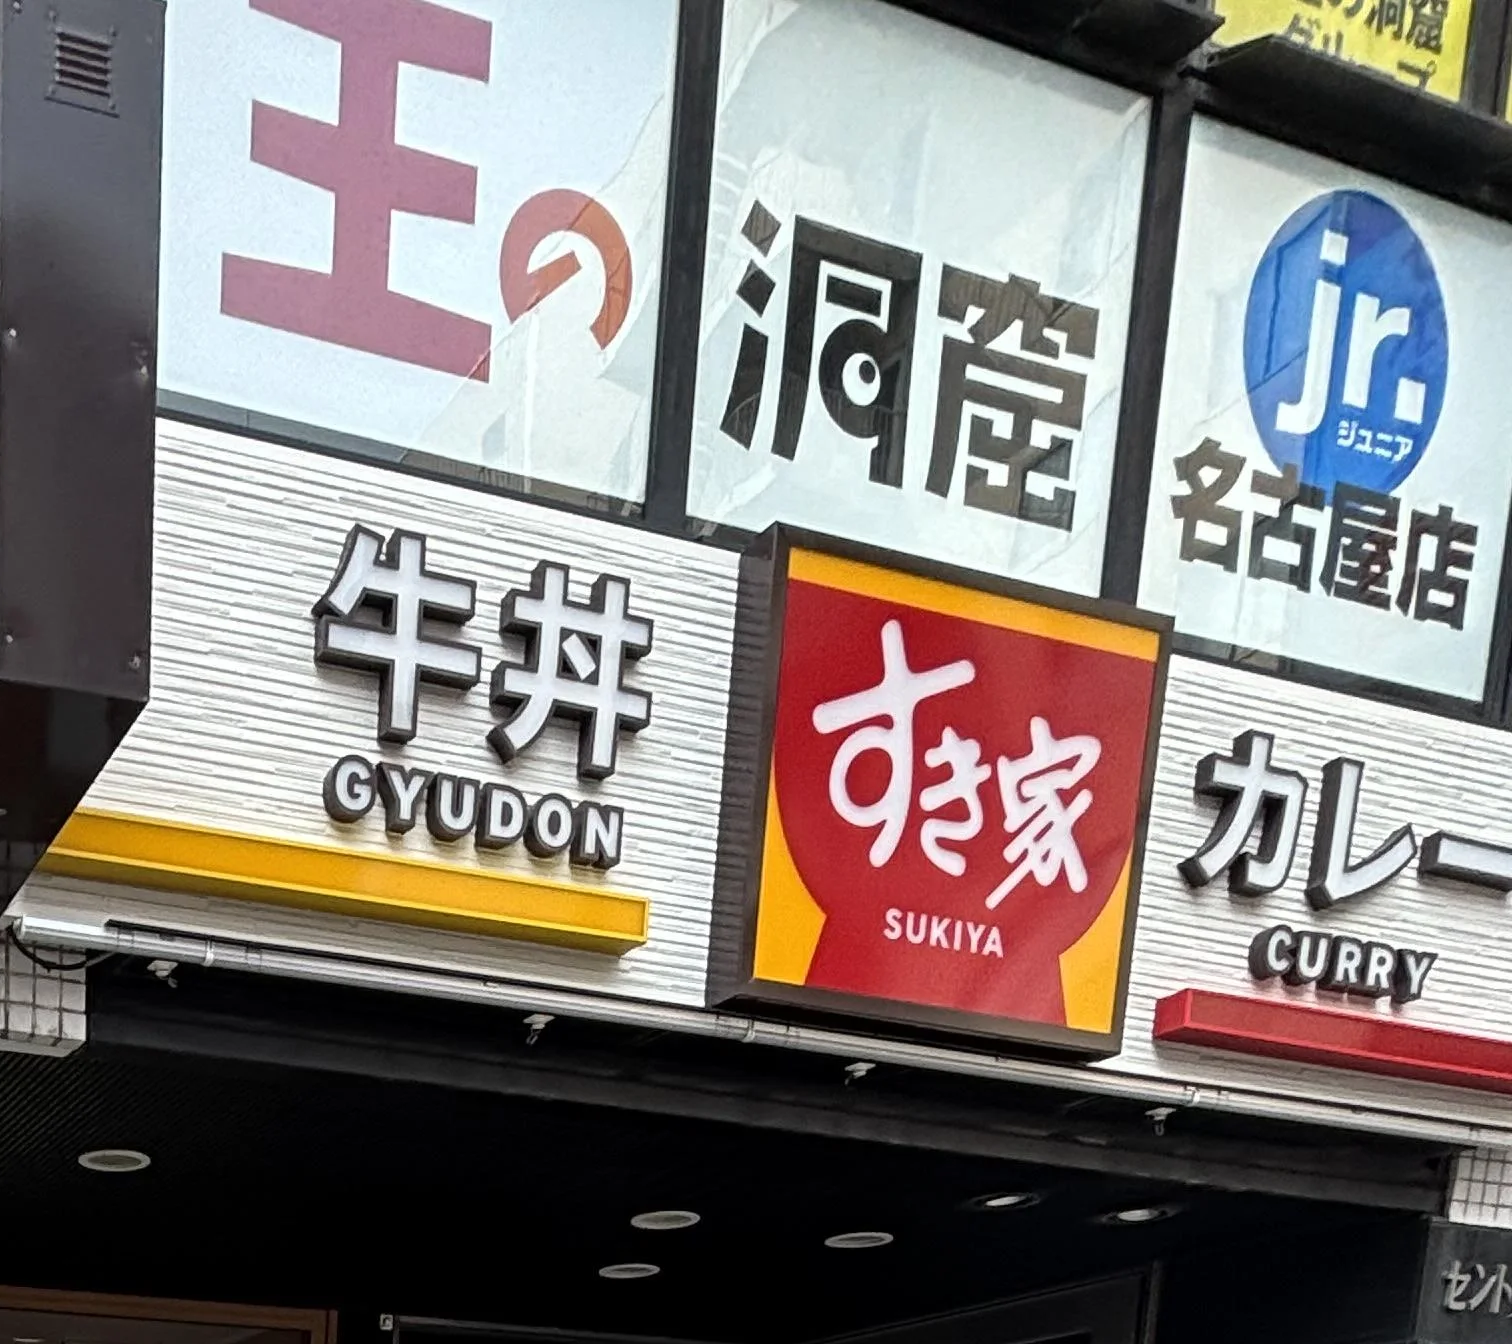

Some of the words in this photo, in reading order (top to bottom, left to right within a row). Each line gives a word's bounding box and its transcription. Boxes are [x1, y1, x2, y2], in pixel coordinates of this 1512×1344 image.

[221, 0, 633, 384] 王の
[720, 199, 1099, 533] 洞窟
[1275, 230, 1428, 436] jr.
[1336, 420, 1414, 463] ジュニア
[1171, 436, 1478, 632] 名古屋店
[312, 524, 654, 782] 牛丼
[323, 754, 625, 871] GYUDON
[812, 618, 1102, 910] すき家
[1178, 729, 1512, 911] カレー
[883, 908, 1004, 958] SUKIYA
[1249, 925, 1439, 1003] CURRY
[1441, 1260, 1512, 1318] セント
